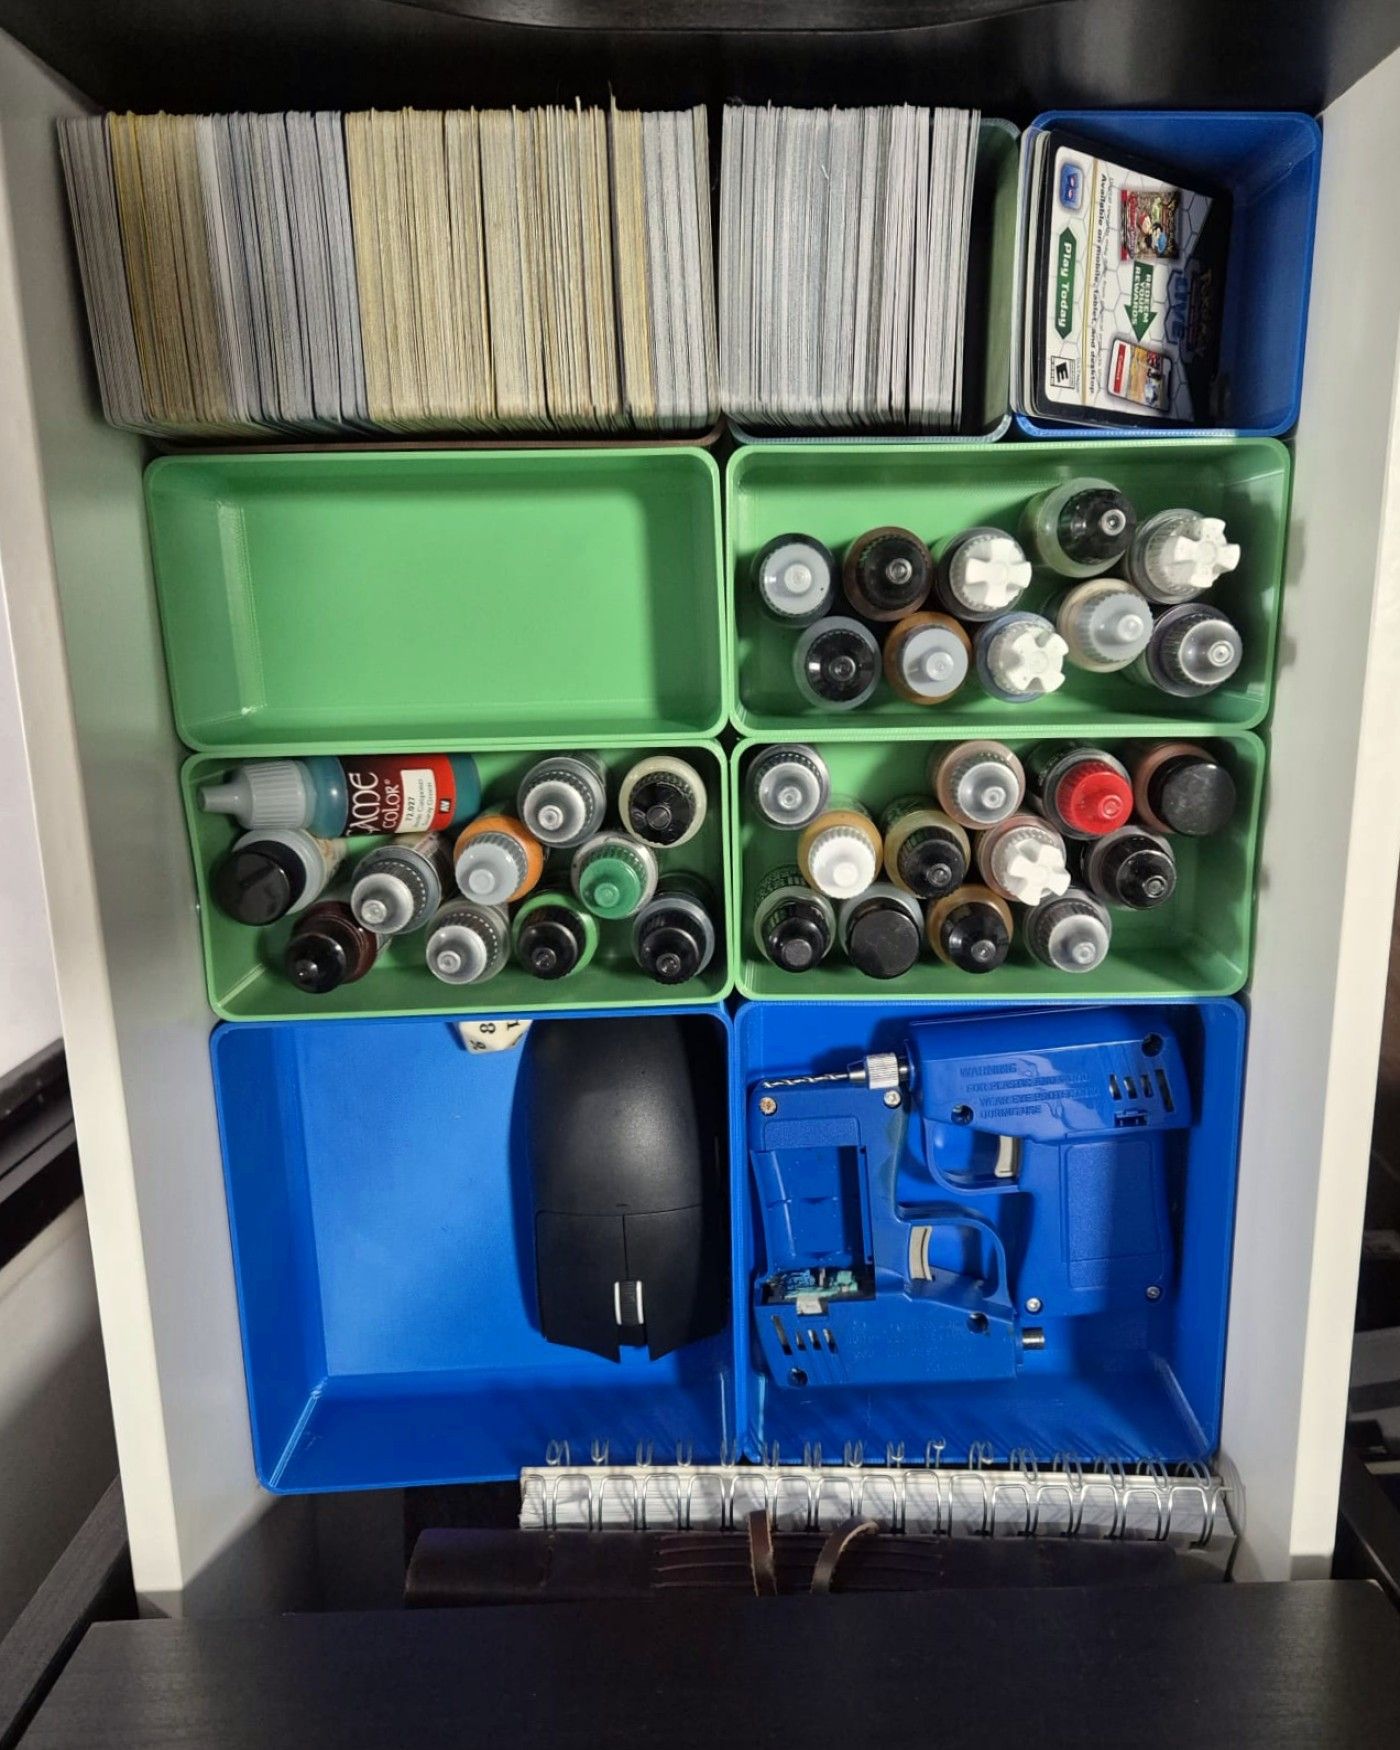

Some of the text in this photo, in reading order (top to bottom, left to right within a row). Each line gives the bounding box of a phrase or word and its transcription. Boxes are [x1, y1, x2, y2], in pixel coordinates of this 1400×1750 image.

[1099, 173, 1107, 226] Available
[1097, 229, 1103, 243] on
[1058, 242, 1072, 327] Play Today
[1131, 266, 1141, 325] REWARDS
[1137, 282, 1146, 313] YOUR
[1142, 274, 1152, 323] REDEEM
[1056, 362, 1068, 383] E
[480, 1022, 496, 1034] 8
